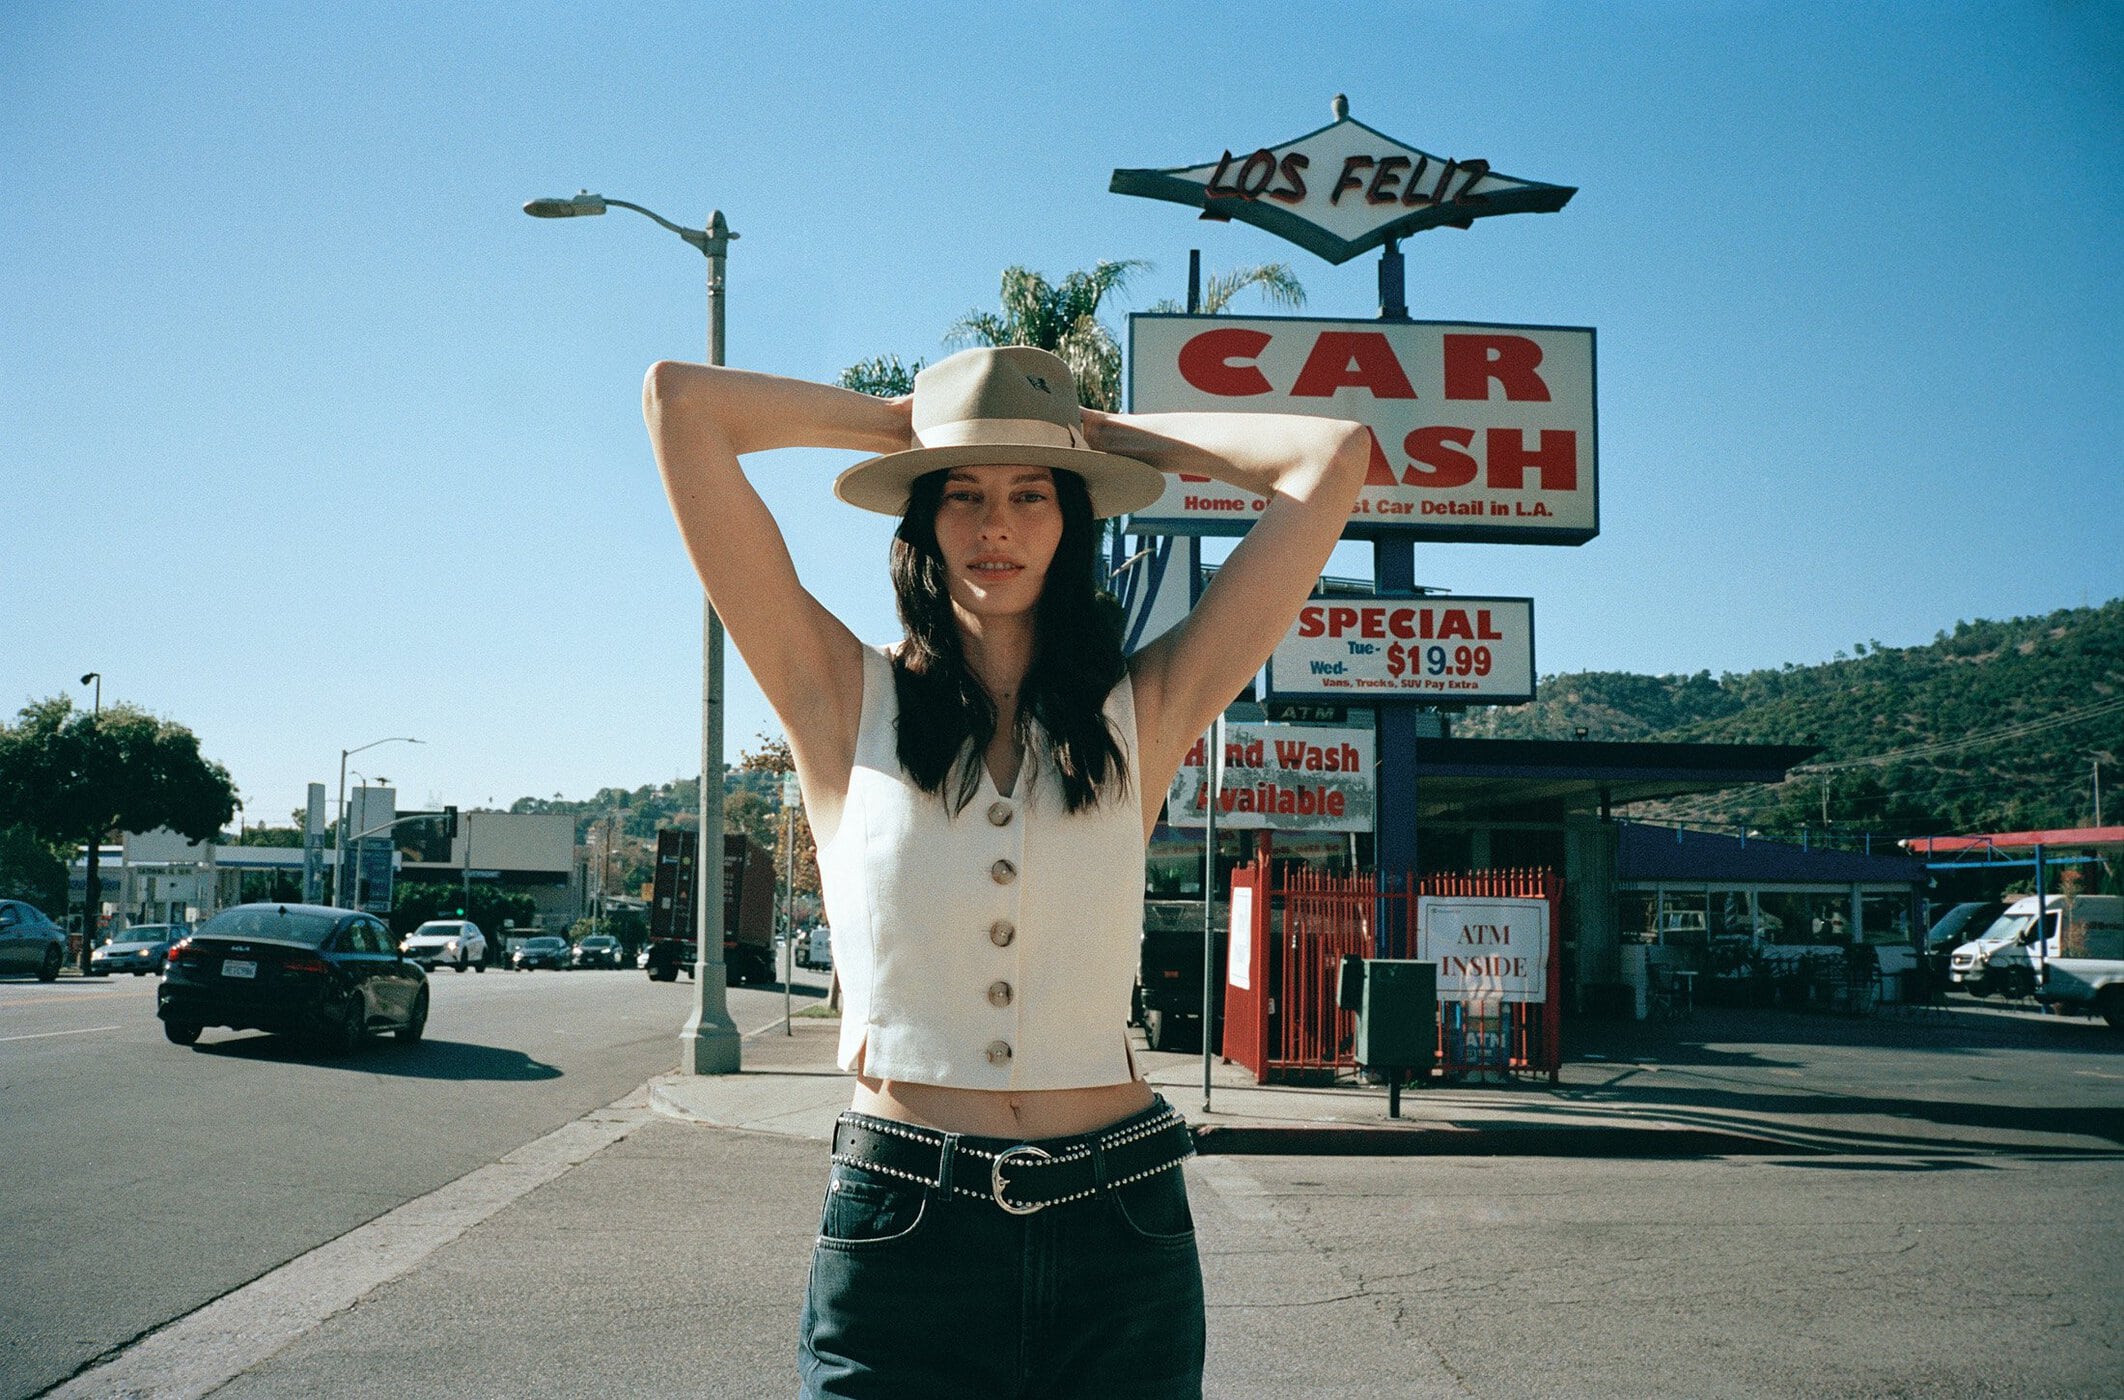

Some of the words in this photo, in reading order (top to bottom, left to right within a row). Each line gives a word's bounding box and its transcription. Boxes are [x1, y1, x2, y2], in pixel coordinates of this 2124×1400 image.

[1205, 149, 1309, 204] LOS
[1331, 155, 1490, 206] FELIZ
[1178, 328, 1552, 402] CAR
[1185, 496, 1245, 513] Home
[1377, 500, 1414, 515] Car
[1421, 500, 1484, 517] Detail
[1491, 501, 1509, 516] in
[1516, 503, 1553, 518] L.A.
[1298, 606, 1502, 640] SPECIAL
[1348, 641, 1381, 655] Tue-
[1310, 660, 1348, 675] Wed-
[1387, 641, 1492, 678] $19.99
[1322, 678, 1353, 688] Vans,
[1356, 679, 1398, 689] Trucks,
[1401, 680, 1421, 689] SUV
[1425, 680, 1445, 691] Pay
[1449, 681, 1479, 690] Extra
[1280, 706, 1335, 720] ATM
[1184, 737, 1265, 769] Hnd
[1275, 740, 1361, 773] Wash
[1458, 924, 1511, 946] ATM
[1441, 955, 1528, 978] INSIDE
